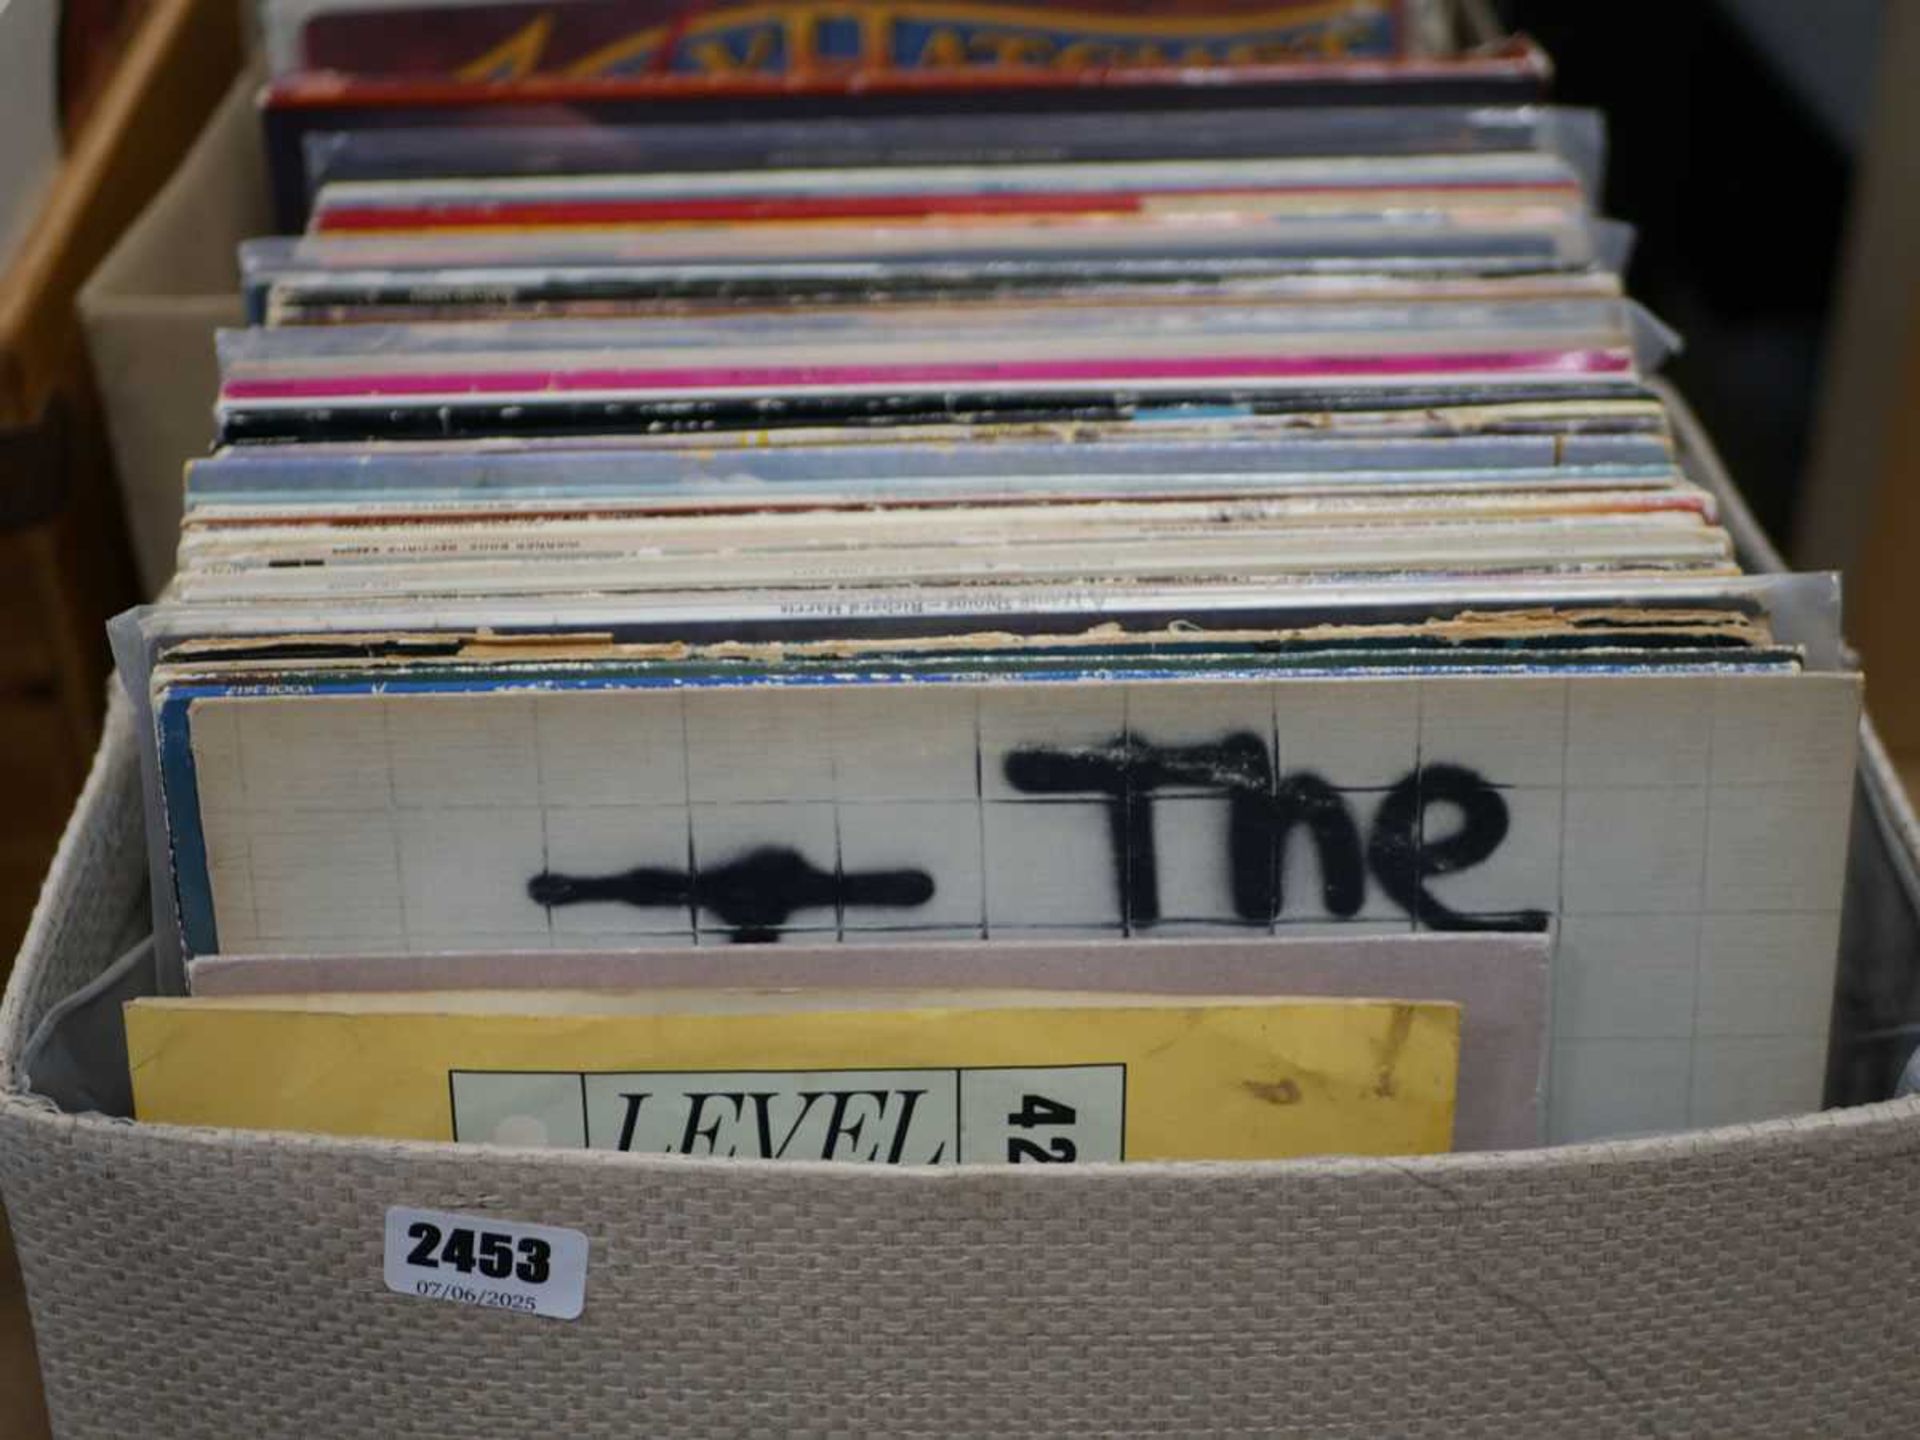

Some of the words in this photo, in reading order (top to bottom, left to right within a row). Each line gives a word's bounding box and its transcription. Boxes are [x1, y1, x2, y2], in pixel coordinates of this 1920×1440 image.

[780, 601, 842, 616] Harris
[849, 600, 923, 616] Richard
[1003, 730, 1549, 932] The
[617, 1090, 946, 1166] LEVEL
[1007, 1094, 1077, 1164] 42
[406, 1221, 551, 1285] 2453
[415, 1279, 536, 1311] 07/06/2025
